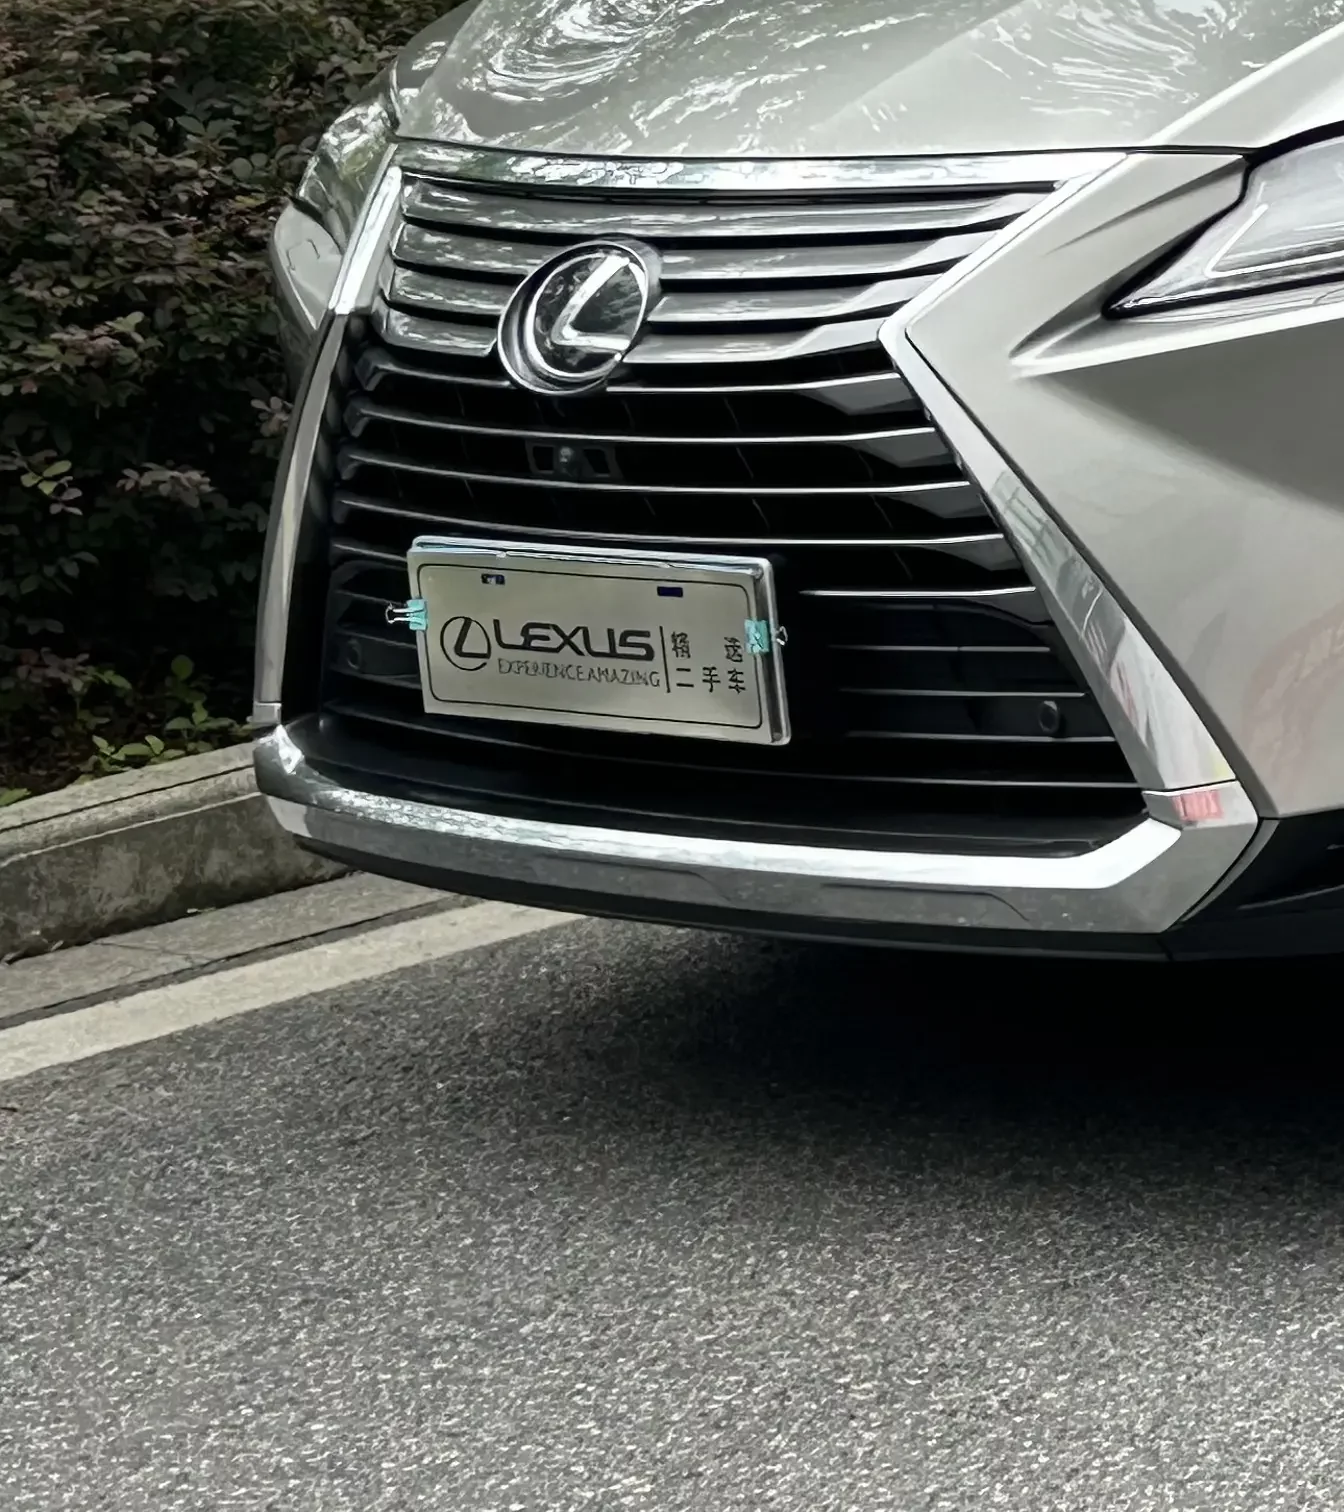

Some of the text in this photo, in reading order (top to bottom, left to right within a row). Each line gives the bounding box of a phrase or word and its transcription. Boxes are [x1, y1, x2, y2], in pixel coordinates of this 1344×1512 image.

[493, 618, 655, 662] LEXUS
[676, 667, 747, 695] 二手车
